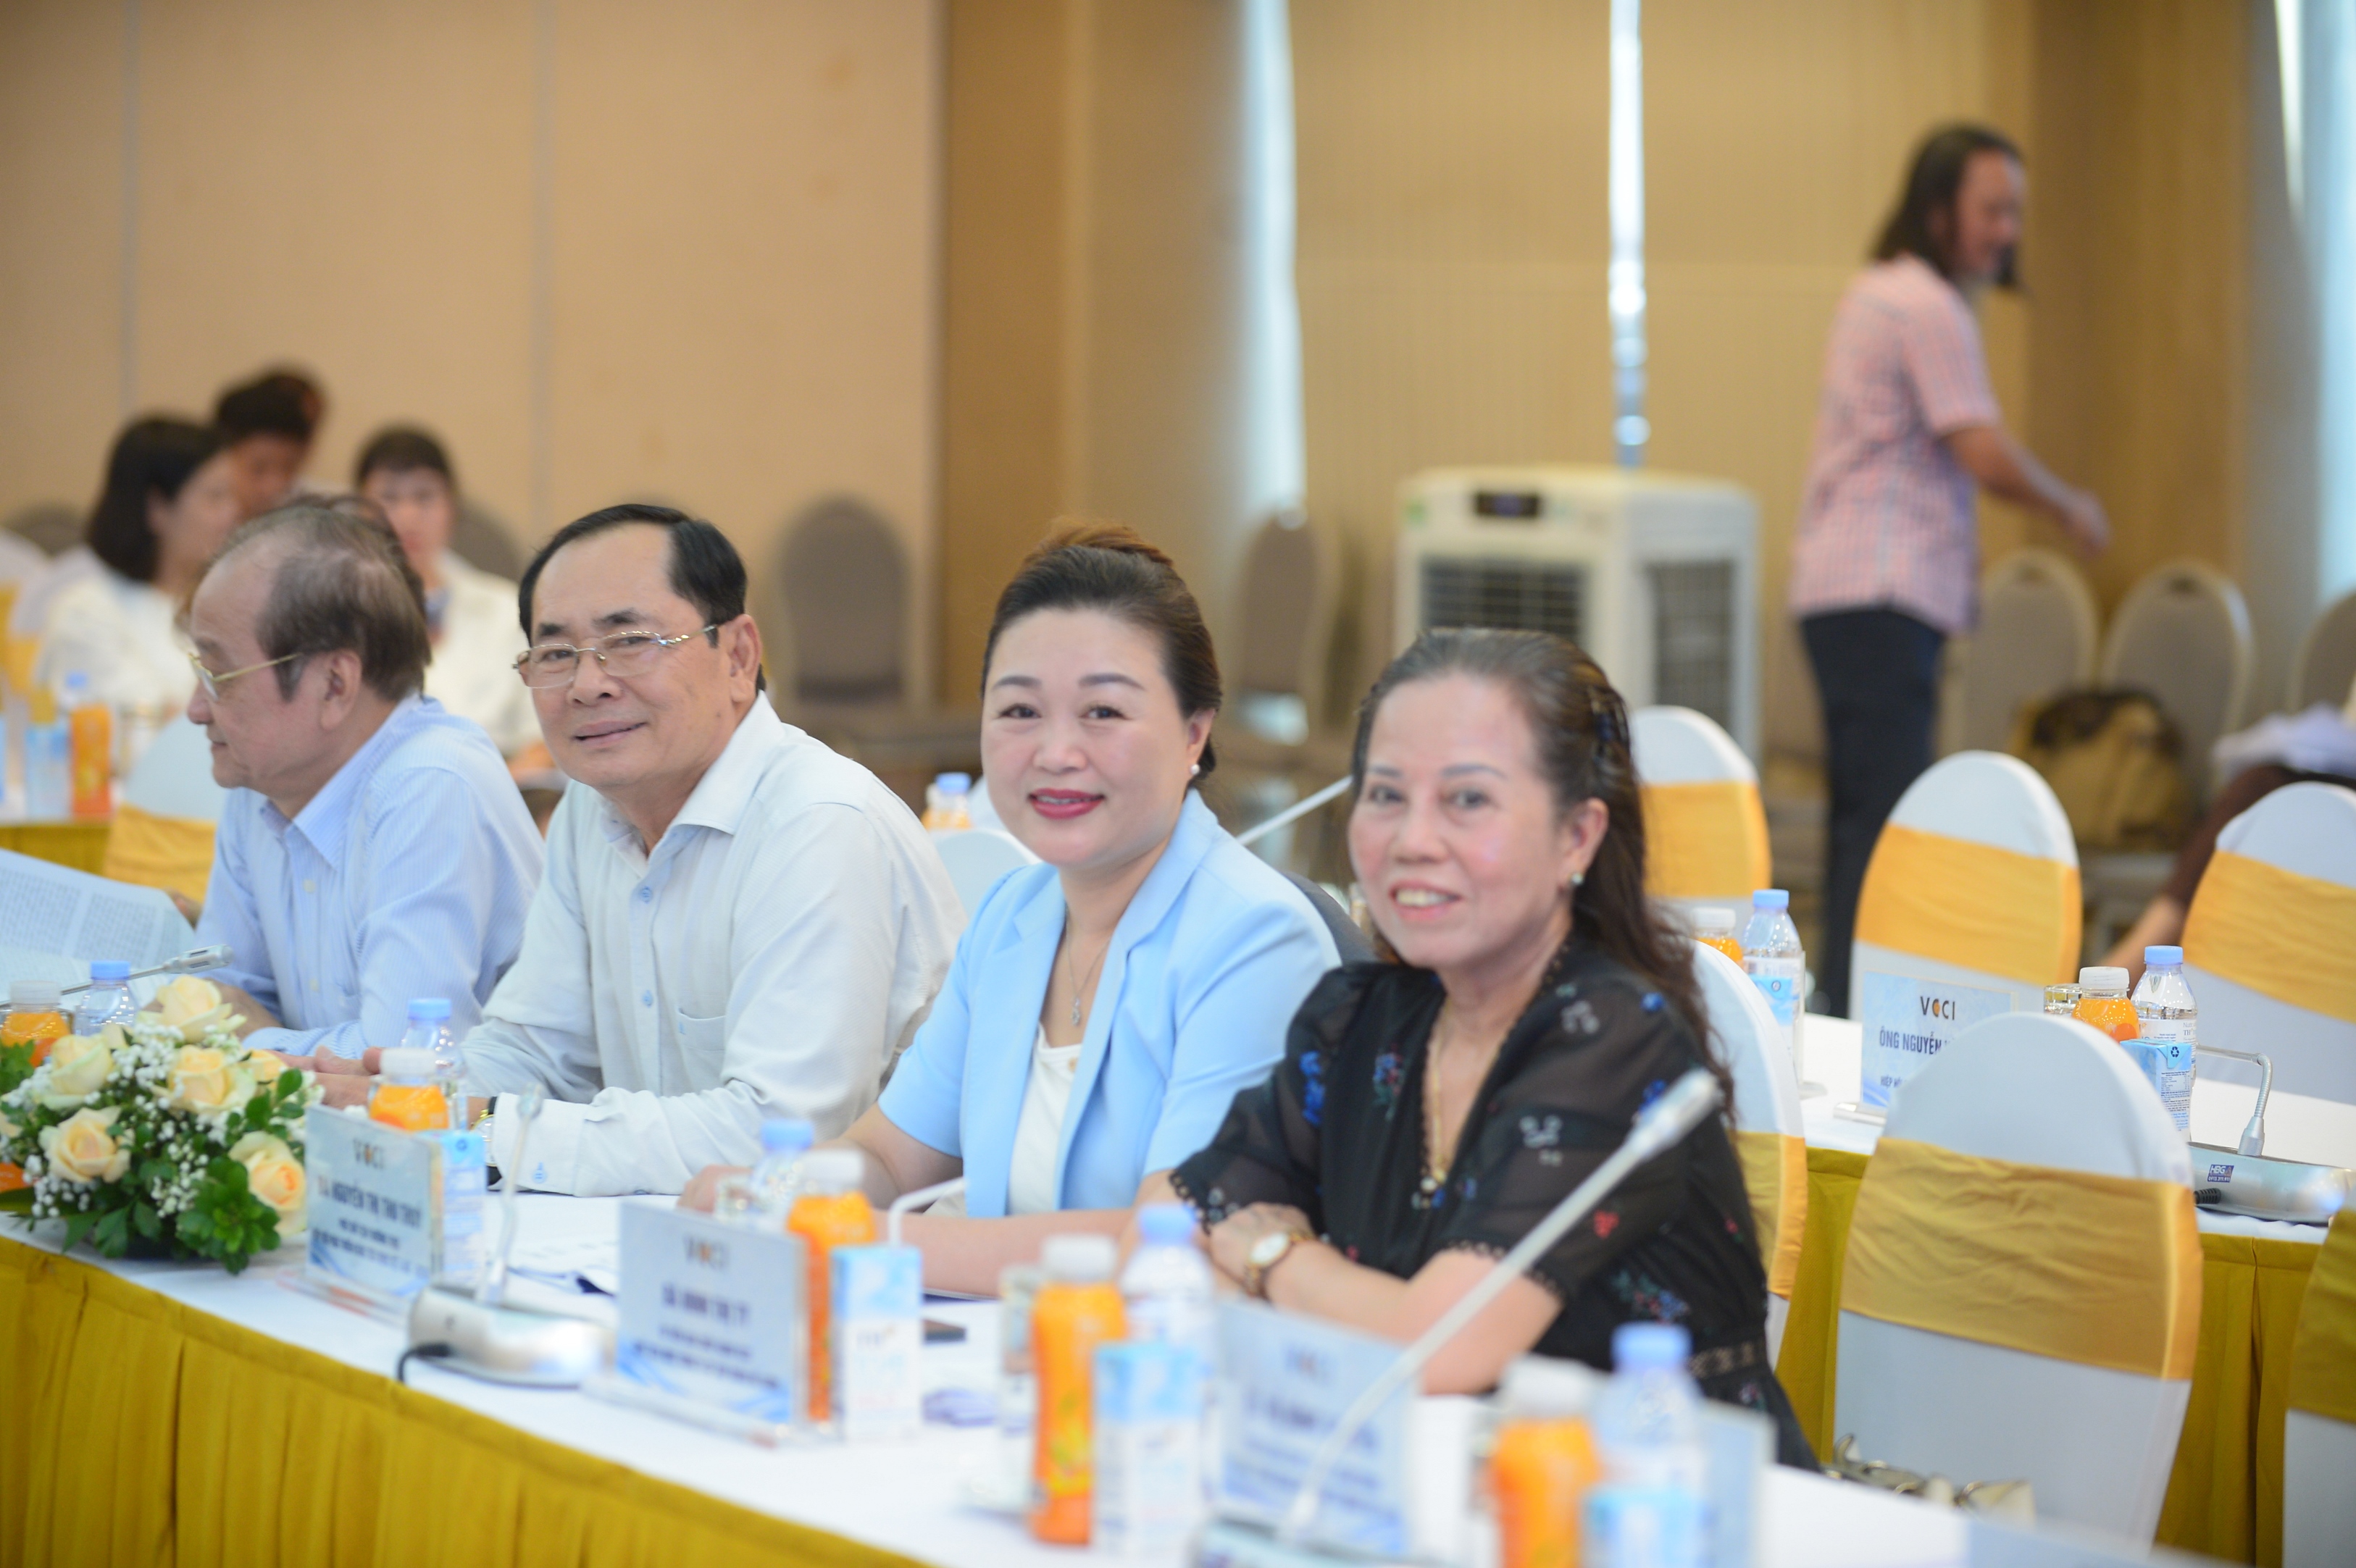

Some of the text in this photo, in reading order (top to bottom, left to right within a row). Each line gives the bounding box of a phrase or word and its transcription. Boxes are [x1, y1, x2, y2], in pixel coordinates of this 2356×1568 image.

[1920, 996, 1955, 1020] VCCI
[1879, 1026, 1942, 1055] ÔNG NGUYỄN
[2210, 1165, 2226, 1174] HBG
